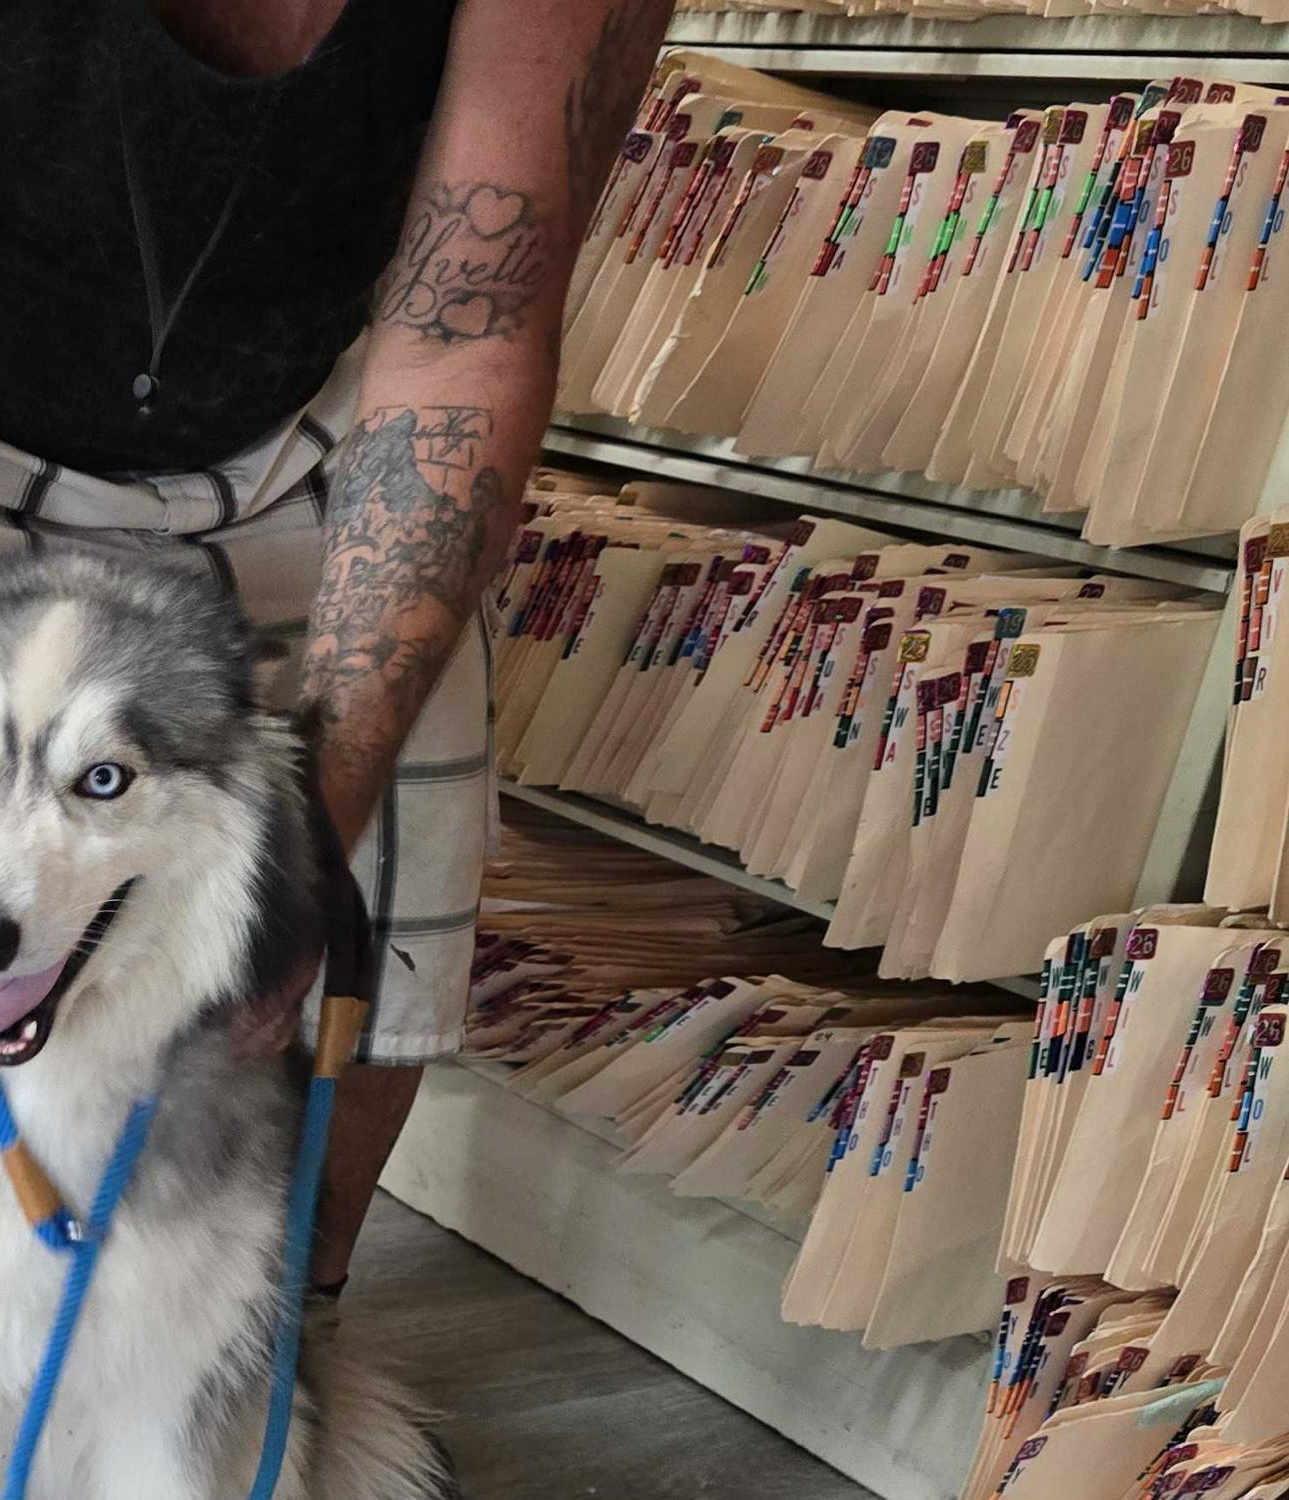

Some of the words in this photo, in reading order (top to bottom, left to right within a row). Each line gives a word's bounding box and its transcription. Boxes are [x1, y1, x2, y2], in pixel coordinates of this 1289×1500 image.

[1170, 146, 1192, 172] 26
[1169, 189, 1178, 215] S
[1221, 210, 1233, 234] O
[1273, 209, 1285, 234] O
[1158, 238, 1170, 262] O
[1272, 567, 1284, 593] V
[1003, 616, 1022, 636] 19
[997, 647, 1009, 669] S
[902, 669, 915, 691] S
[1256, 666, 1267, 691] R
[893, 706, 909, 729] W
[849, 722, 862, 741] N
[975, 724, 988, 746] E
[996, 729, 1010, 752] Z
[884, 741, 897, 763] A
[989, 767, 1003, 789] E
[1128, 933, 1154, 957] 26
[1129, 969, 1145, 993] W
[1210, 974, 1230, 994] 26
[1200, 1015, 1216, 1037] W
[1256, 1018, 1281, 1042] 26
[1260, 1056, 1274, 1081] W
[1252, 1098, 1264, 1120] O
[848, 1132, 859, 1151] O
[882, 1149, 893, 1168] O
[915, 1164, 925, 1183] O
[1123, 1350, 1146, 1370] 26
[1012, 1465, 1026, 1484] Y
